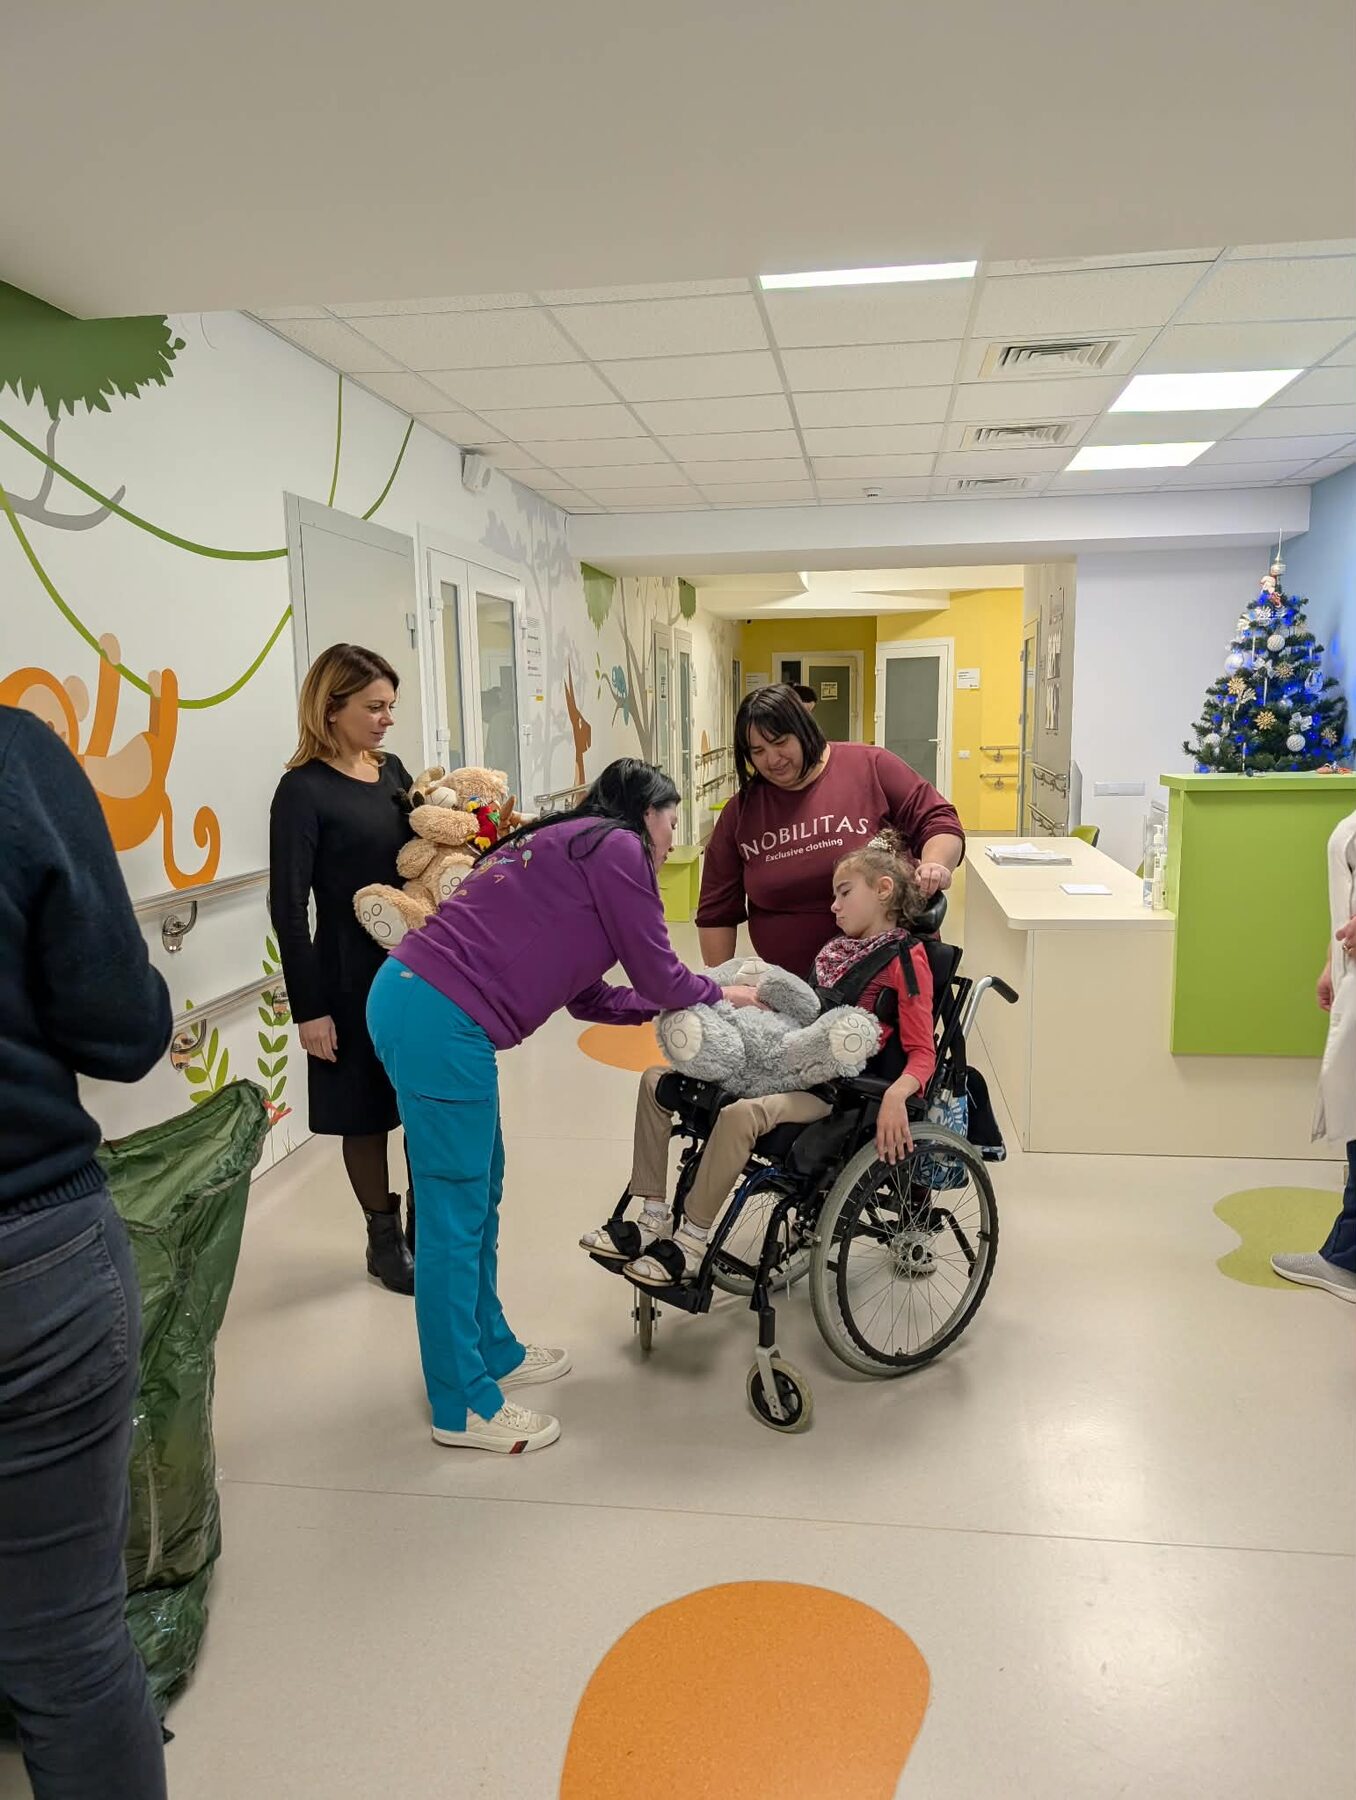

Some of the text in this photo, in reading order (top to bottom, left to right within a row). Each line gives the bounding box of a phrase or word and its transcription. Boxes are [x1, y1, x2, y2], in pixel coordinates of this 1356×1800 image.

[740, 814, 869, 861] NOBILITAS
[765, 838, 843, 862] Exclusive clothing
